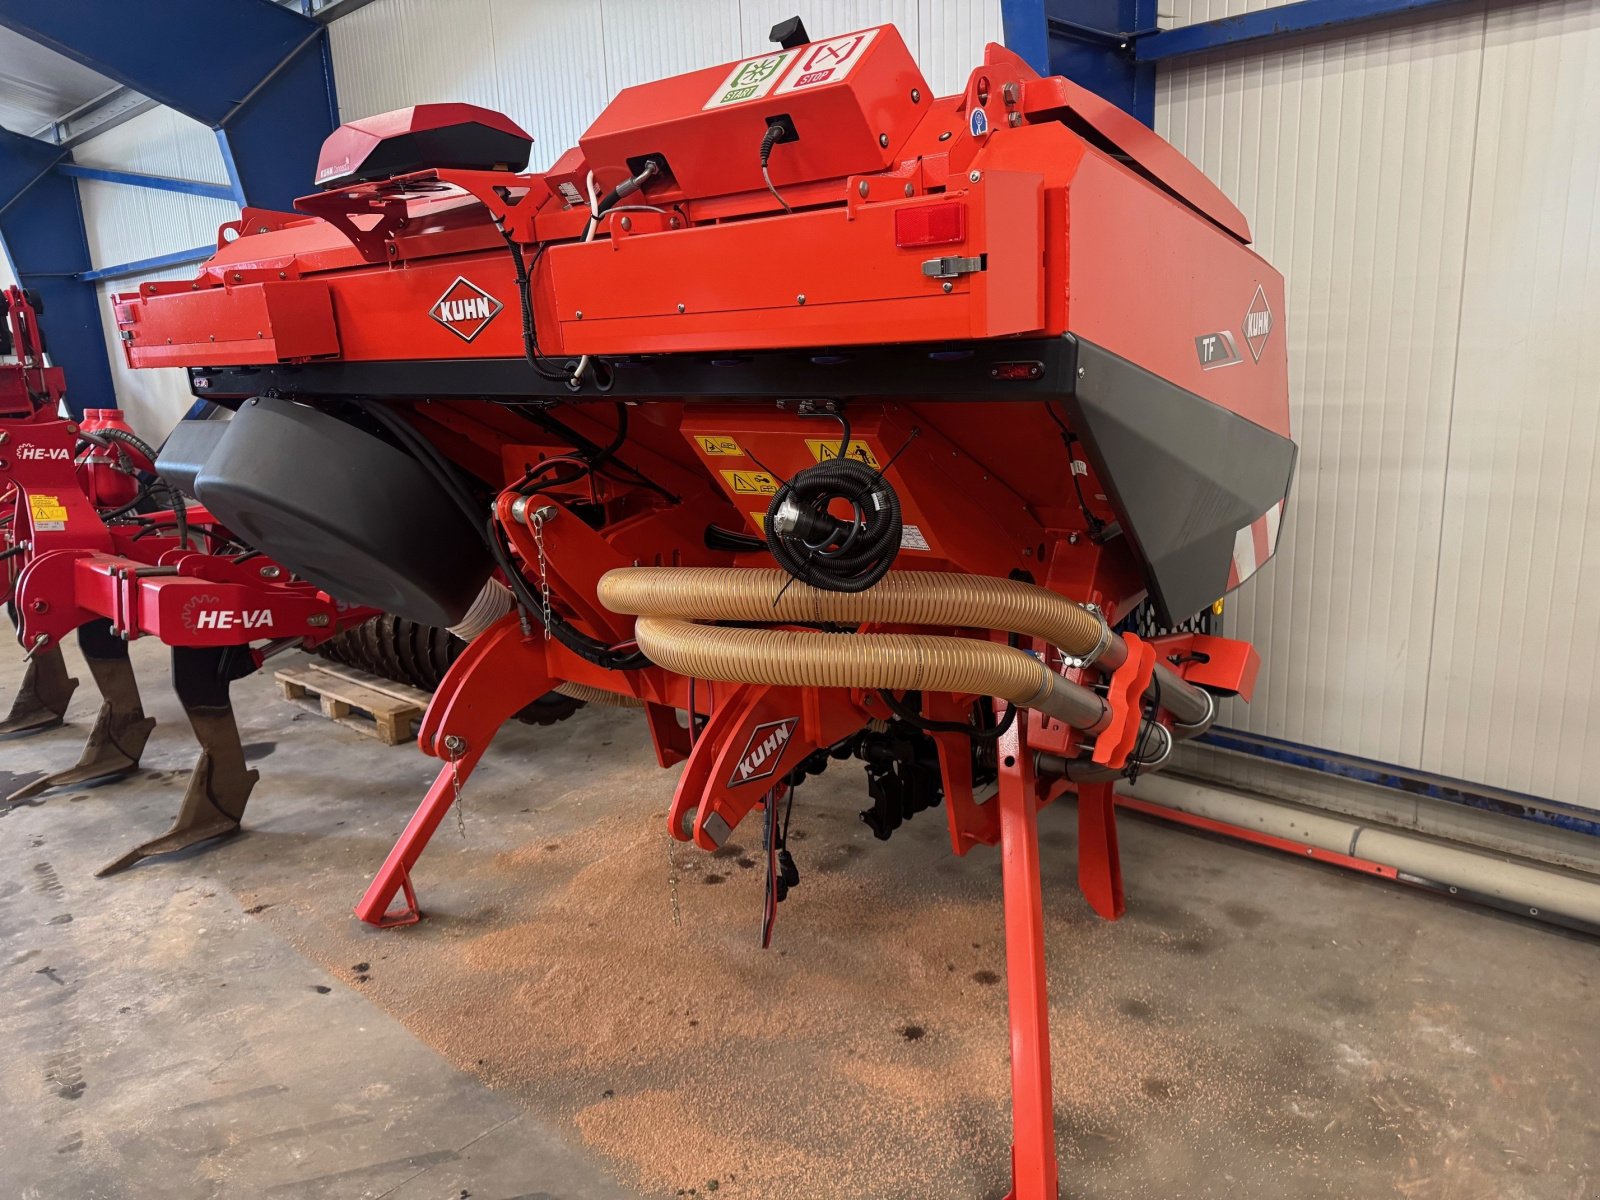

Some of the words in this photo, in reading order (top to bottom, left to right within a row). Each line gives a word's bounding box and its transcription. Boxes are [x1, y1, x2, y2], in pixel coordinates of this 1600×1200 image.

[800, 70, 829, 85] STOP
[724, 85, 755, 101] START
[440, 297, 490, 322] KUHN
[1247, 310, 1269, 338] KUHN
[1202, 336, 1216, 362] TF
[22, 448, 70, 460] HE-VA
[196, 609, 274, 629] HE-VA
[739, 722, 789, 779] KUHN
